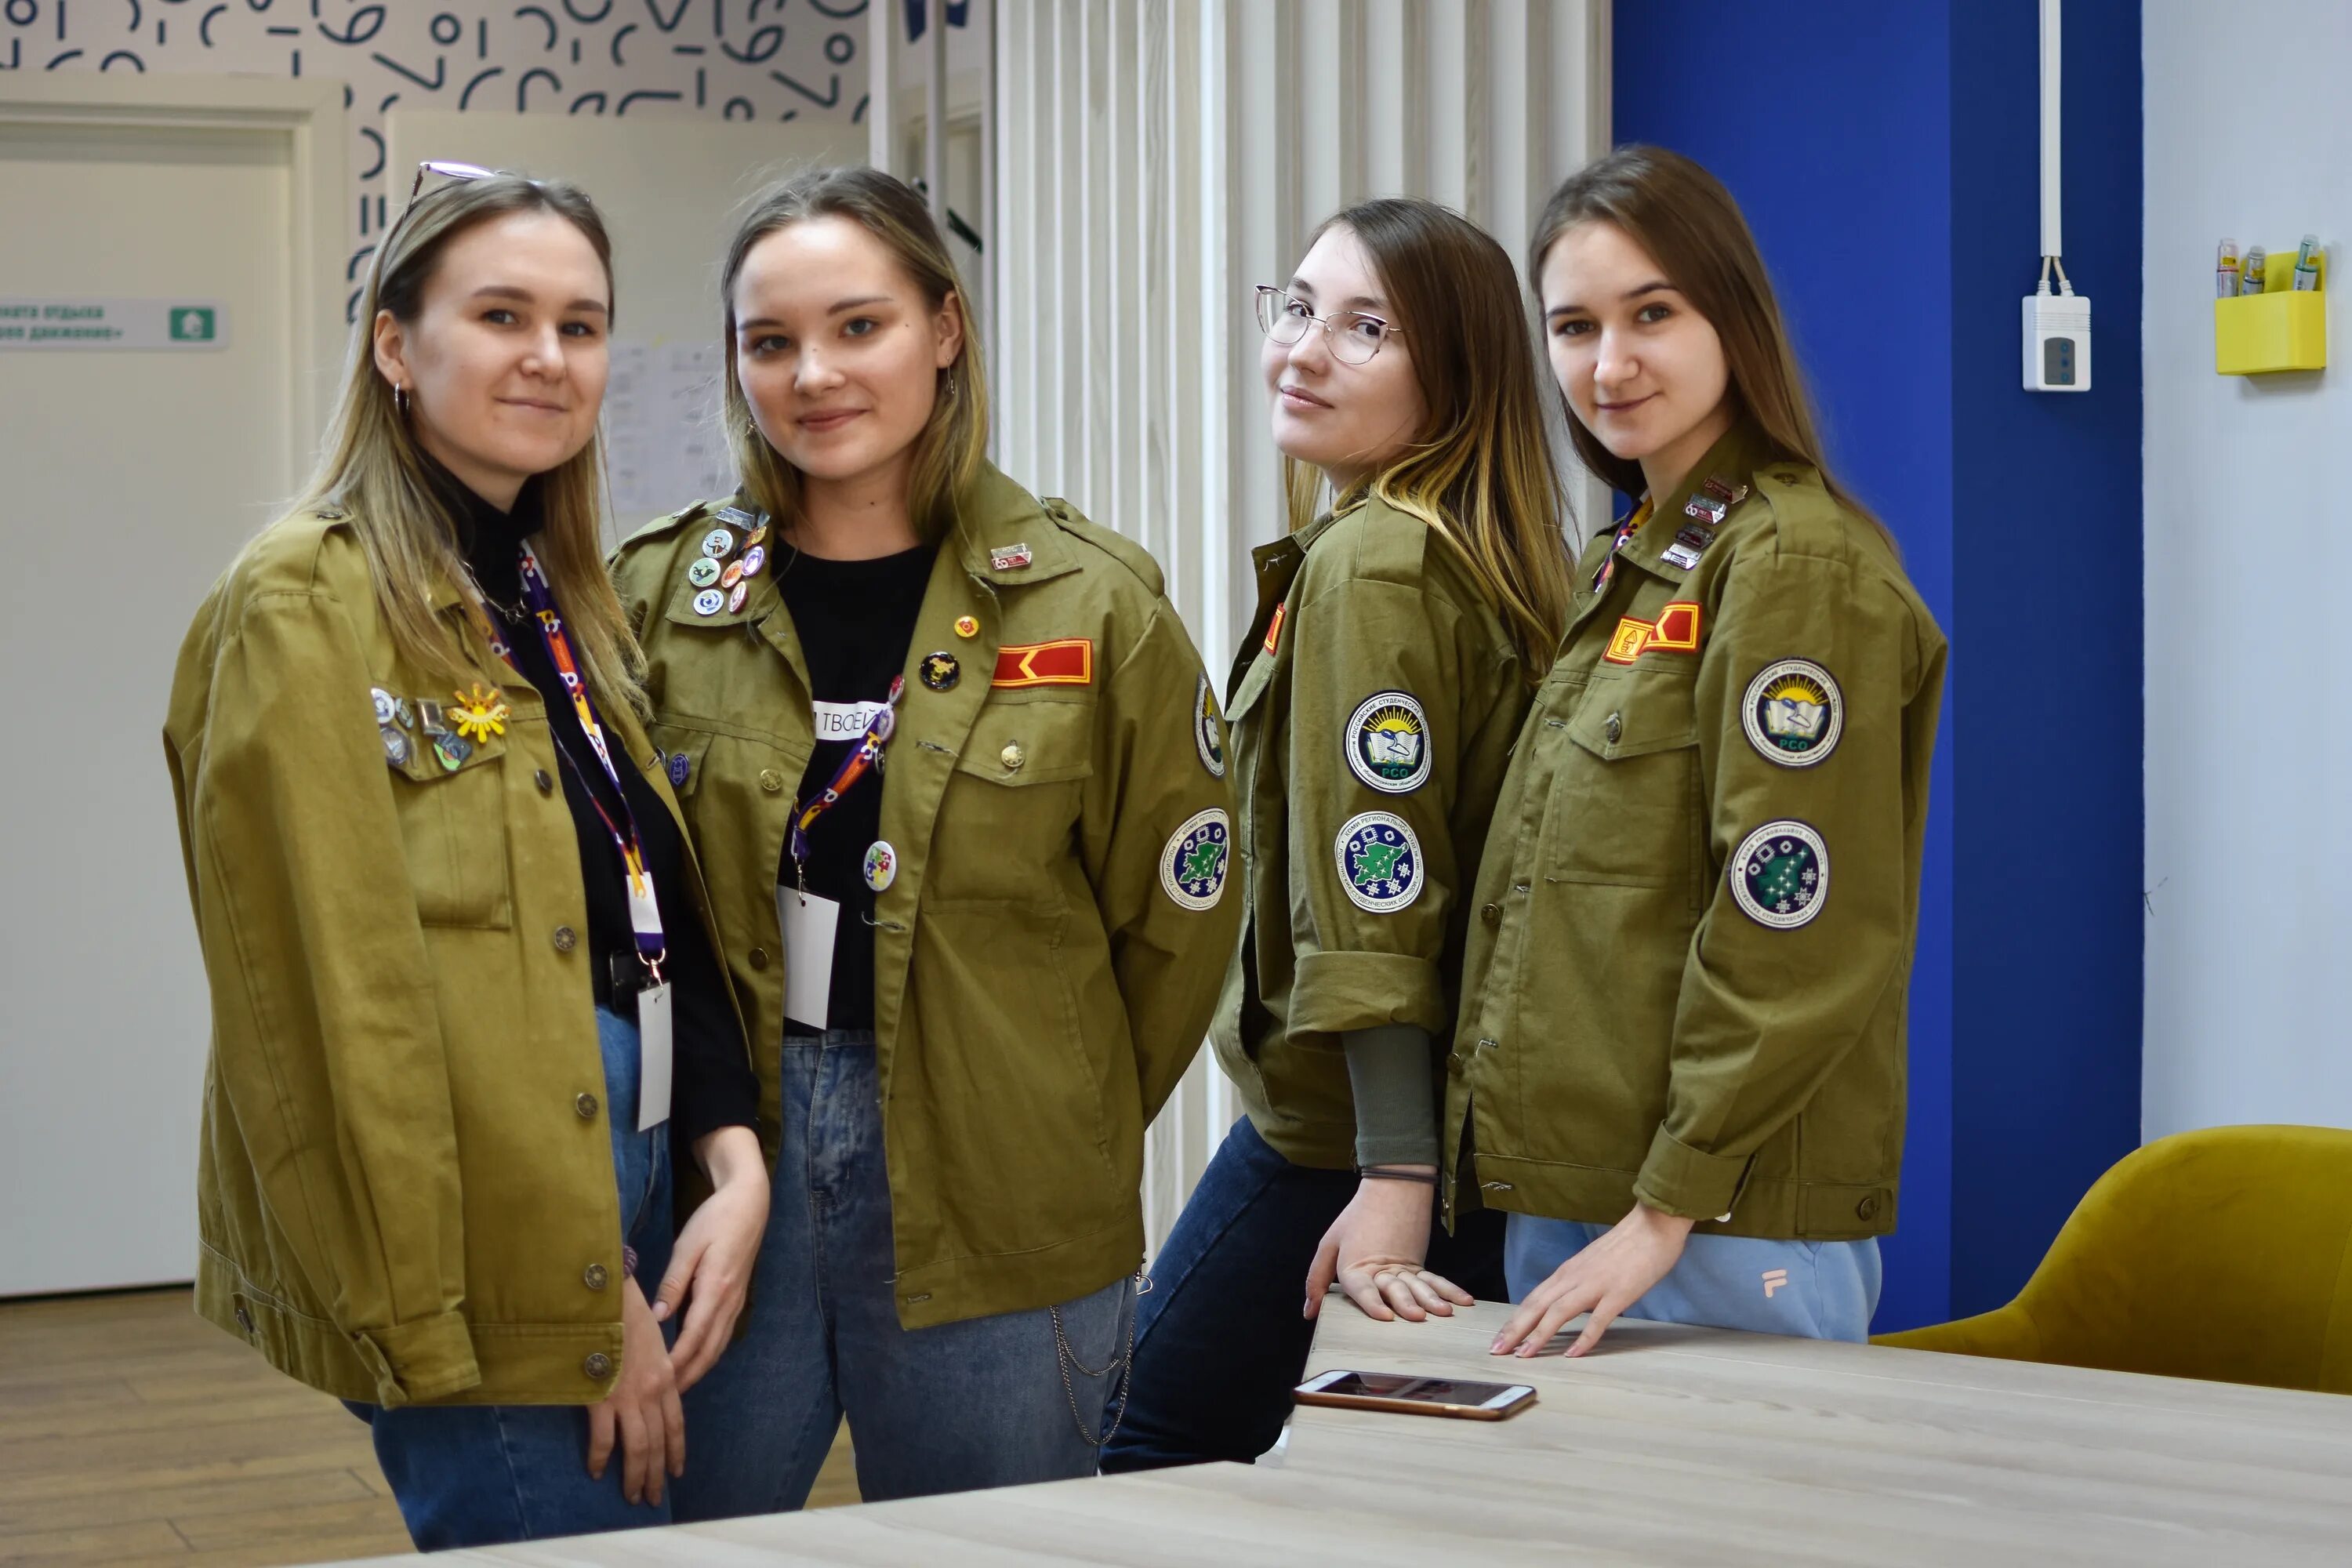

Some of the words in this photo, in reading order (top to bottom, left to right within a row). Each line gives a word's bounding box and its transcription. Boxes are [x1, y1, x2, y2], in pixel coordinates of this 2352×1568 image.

[823, 709, 876, 731] ТВОЕЙ
[1352, 702, 1377, 739] РОССИЙСКИЕ
[1378, 698, 1420, 714] СТУДЕНЧЕСКИЕ
[1780, 739, 1808, 750] РСО
[1382, 768, 1409, 778] РСО
[1182, 821, 1199, 835] КОМИ
[1345, 822, 1361, 837] КОМИ
[1361, 815, 1408, 834] РЕГИОНАЛЬНОЕ
[1352, 890, 1398, 908] СТУДЕНЧЕСКИХ
